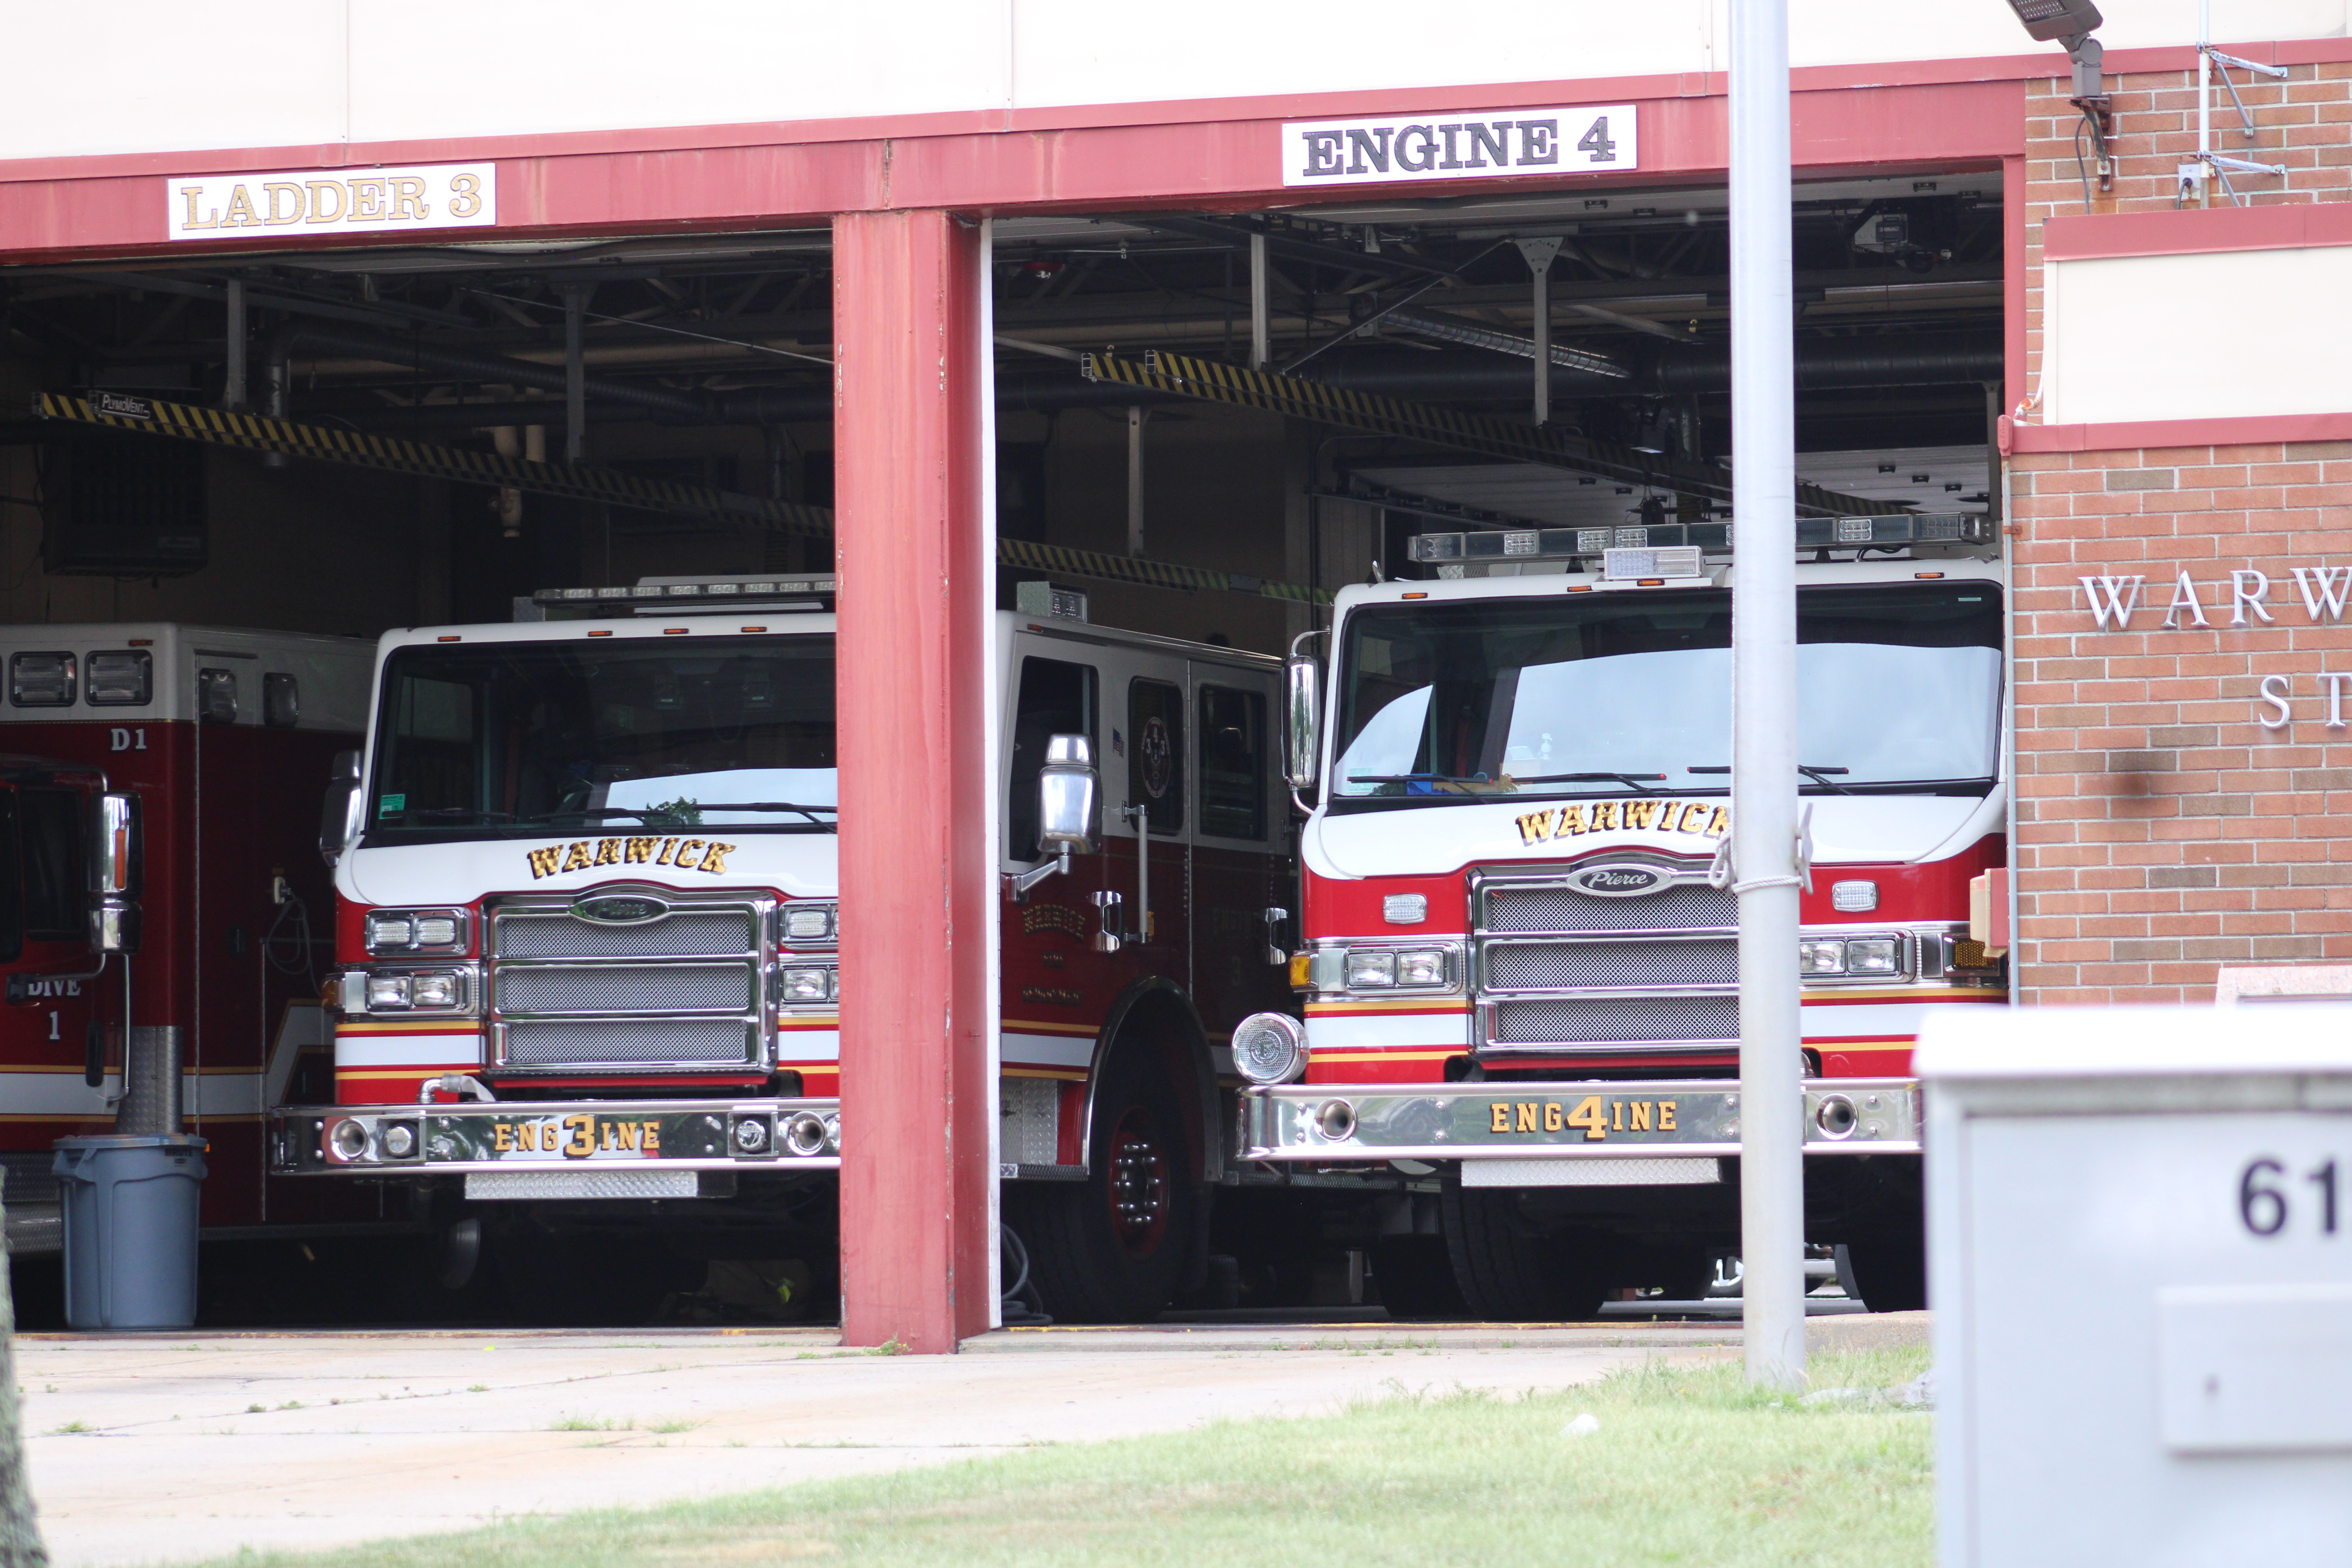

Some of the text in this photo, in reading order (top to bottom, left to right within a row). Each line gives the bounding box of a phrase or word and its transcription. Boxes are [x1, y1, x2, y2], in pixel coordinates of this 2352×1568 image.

[1302, 116, 1616, 176] ENGINE 4
[181, 174, 482, 230] LADDER 3
[2078, 566, 2352, 628] WARW
[2259, 672, 2352, 729] ST
[110, 728, 148, 751] D1
[527, 837, 737, 880] WARWICK
[1588, 871, 1649, 892] Pierce
[595, 899, 649, 918] Pierce
[27, 980, 82, 997] DIVE
[49, 1010, 60, 1040] 1
[2240, 1158, 2336, 1236] 61
